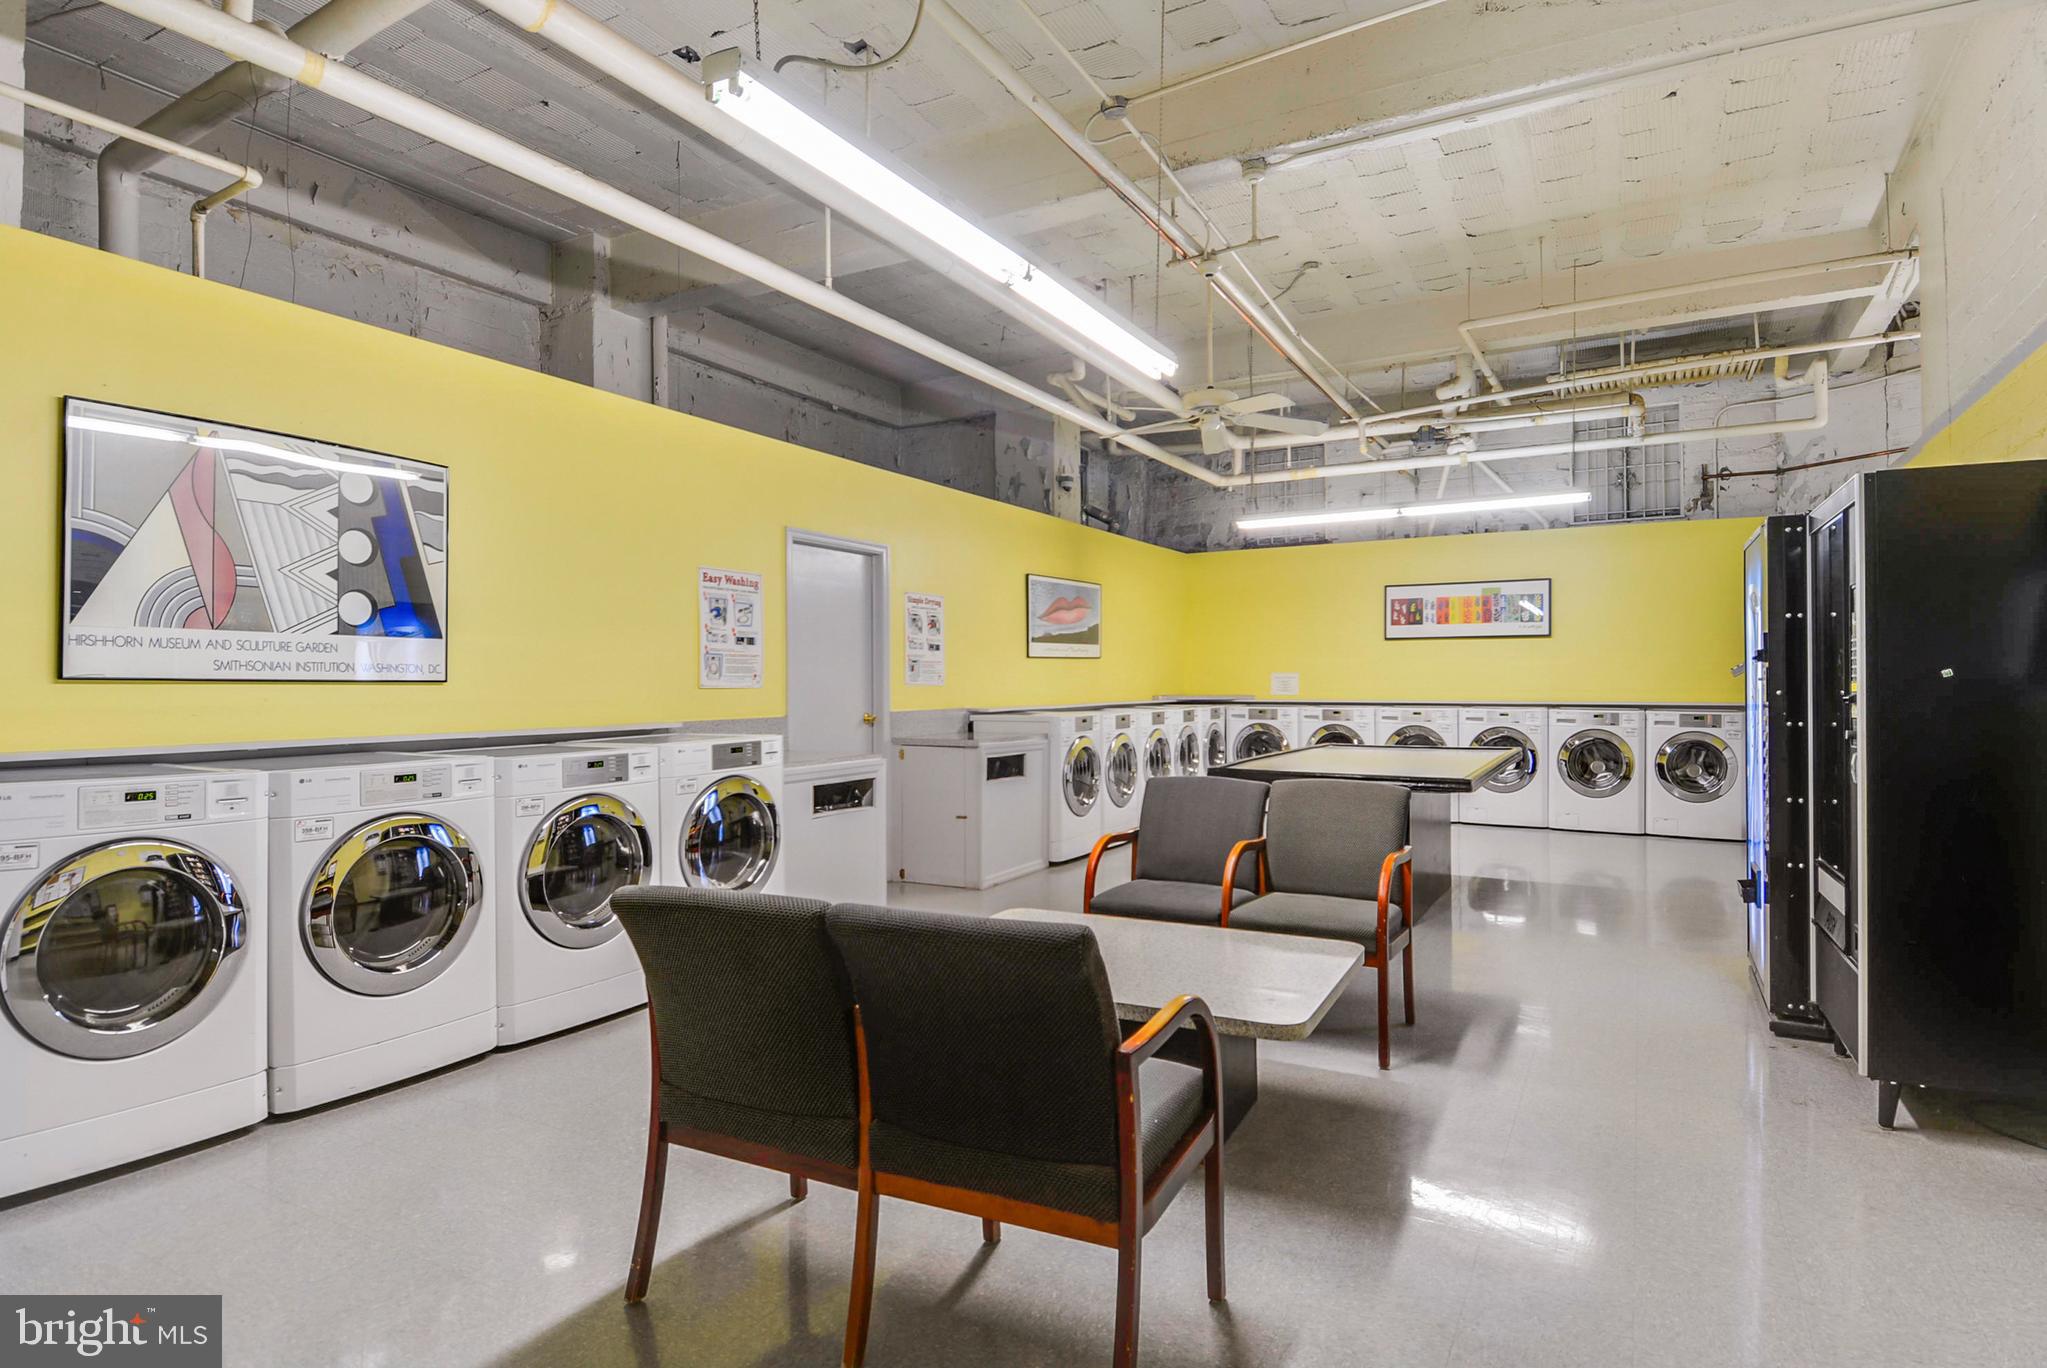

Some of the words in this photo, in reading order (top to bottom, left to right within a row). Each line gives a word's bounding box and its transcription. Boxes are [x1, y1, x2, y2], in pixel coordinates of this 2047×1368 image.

[703, 572, 722, 586] Easy
[724, 575, 760, 590] Washing
[67, 634, 143, 648] HIRSHHORN
[148, 637, 200, 650] MUSEUM
[205, 639, 232, 651] AND
[236, 639, 293, 653] SCULPTURE
[295, 641, 339, 653] GARDEN
[212, 659, 291, 672] SMITHSONIAN
